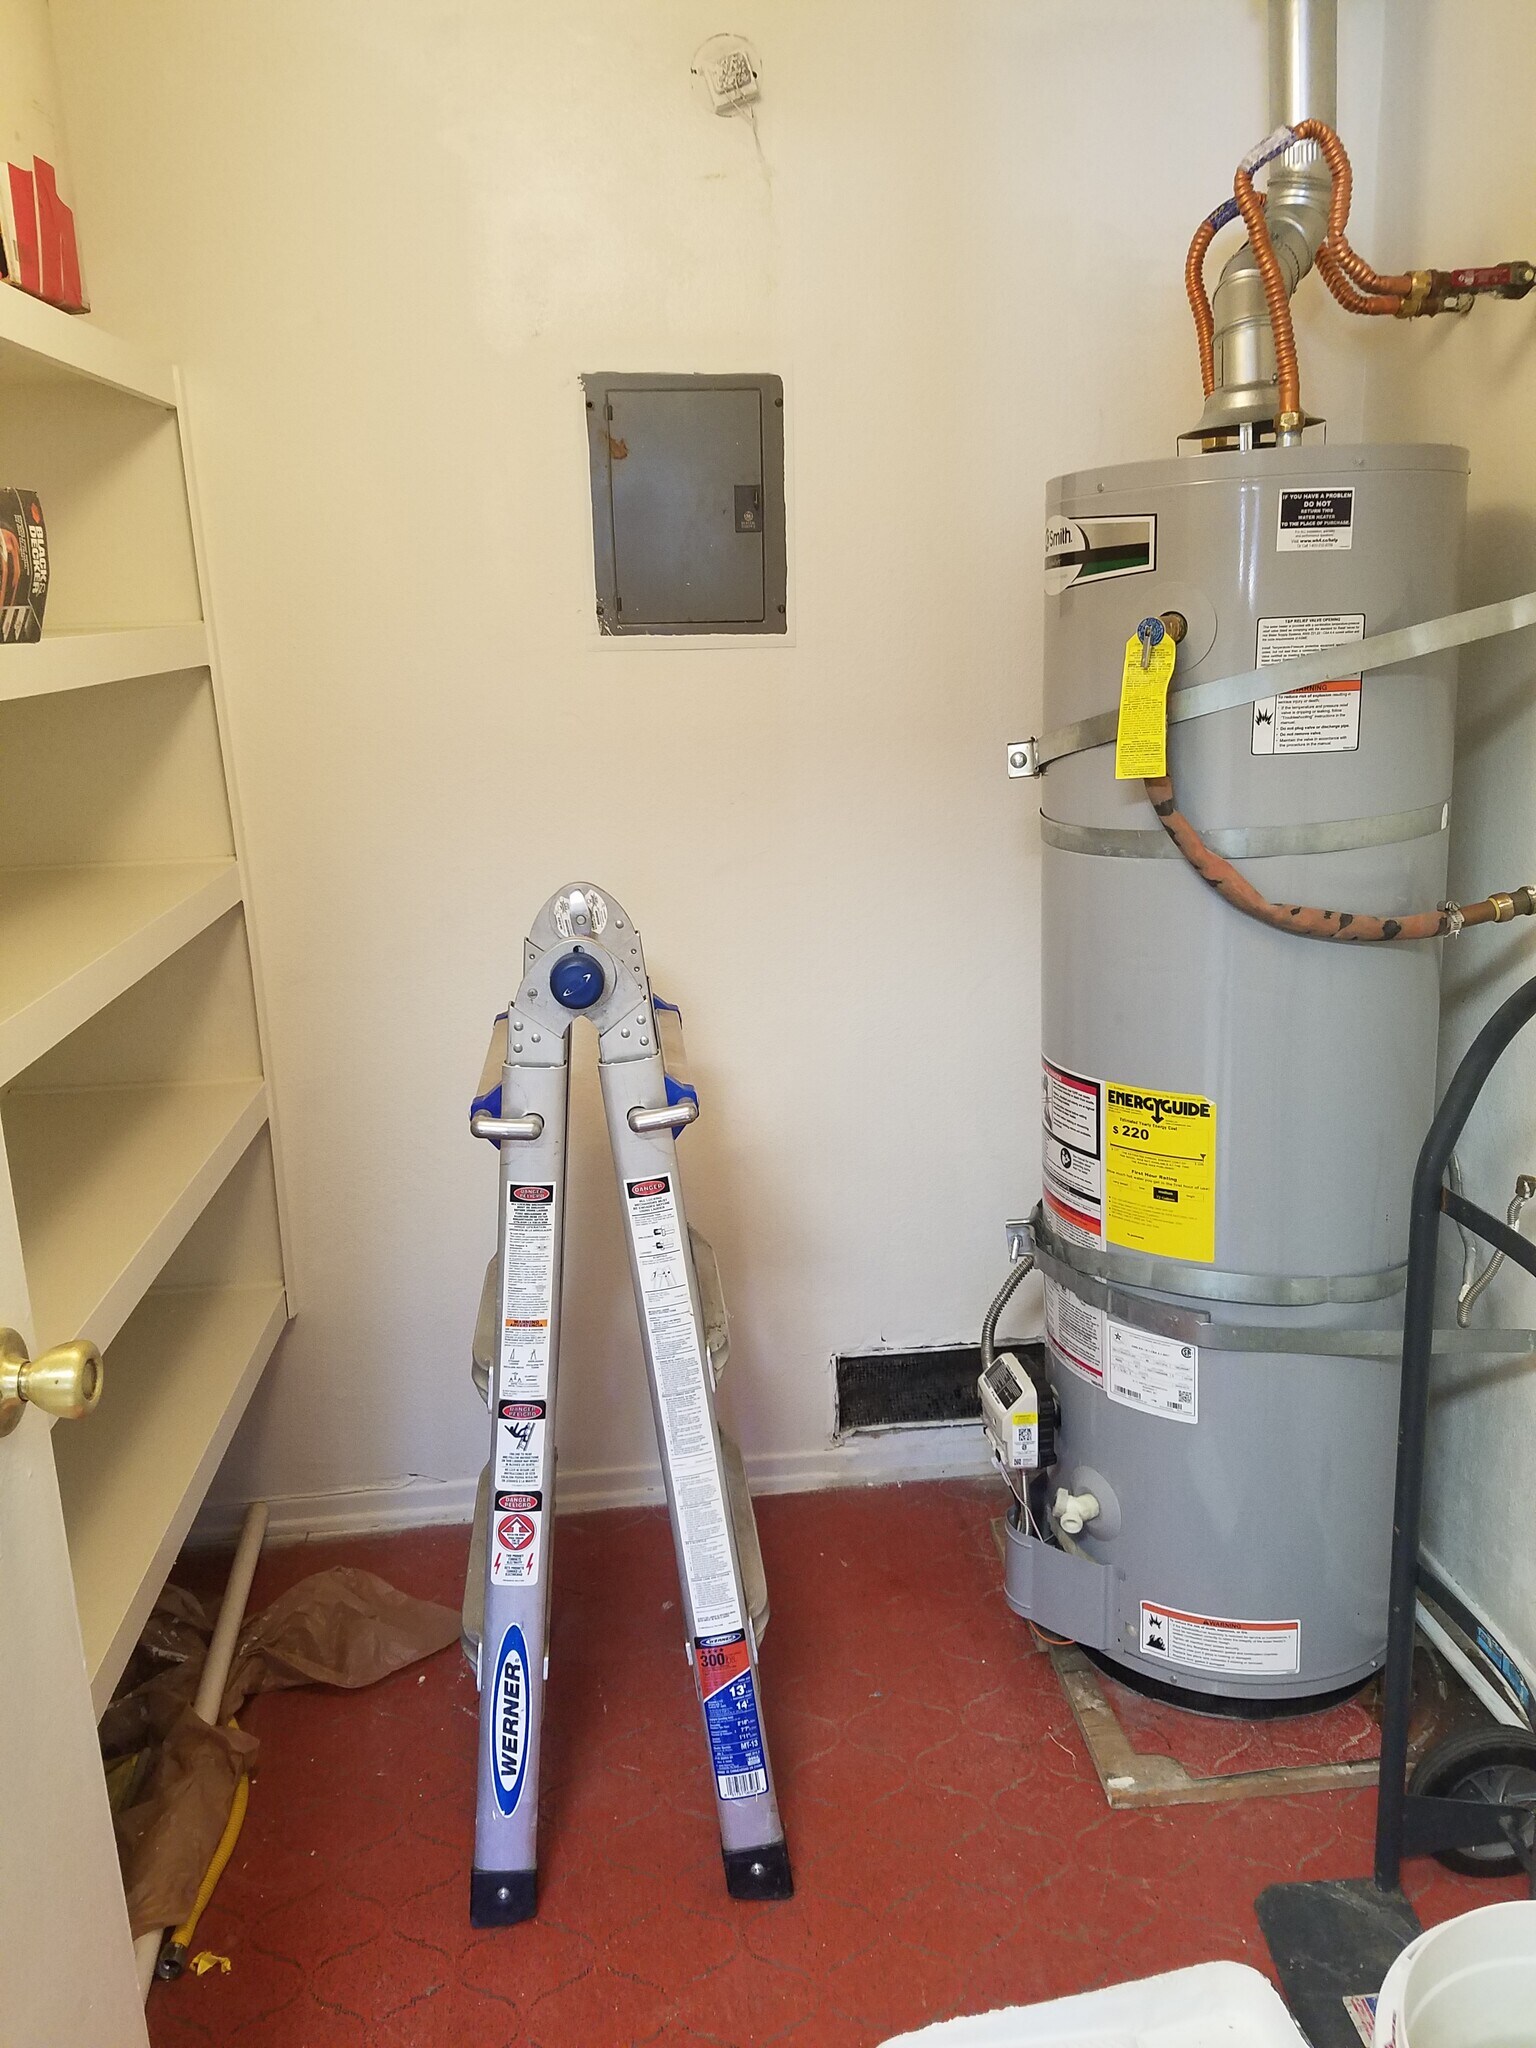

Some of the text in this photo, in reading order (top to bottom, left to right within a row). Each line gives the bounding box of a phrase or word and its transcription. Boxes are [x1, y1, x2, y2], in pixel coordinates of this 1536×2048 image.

[29, 525, 40, 594] DECKER
[35, 525, 47, 583] BLACK
[1108, 1089, 1210, 1119] ENERGYGUIDE
[1113, 1125, 1149, 1140] $ 220
[634, 1184, 662, 1192] DANGER
[1209, 1620, 1241, 1629] WARNING
[700, 1653, 725, 1667] 300
[729, 1684, 746, 1697] 13'
[736, 1699, 749, 1710] 14'
[501, 1662, 520, 1776] WERNER
[740, 1739, 759, 1750] MT-13
